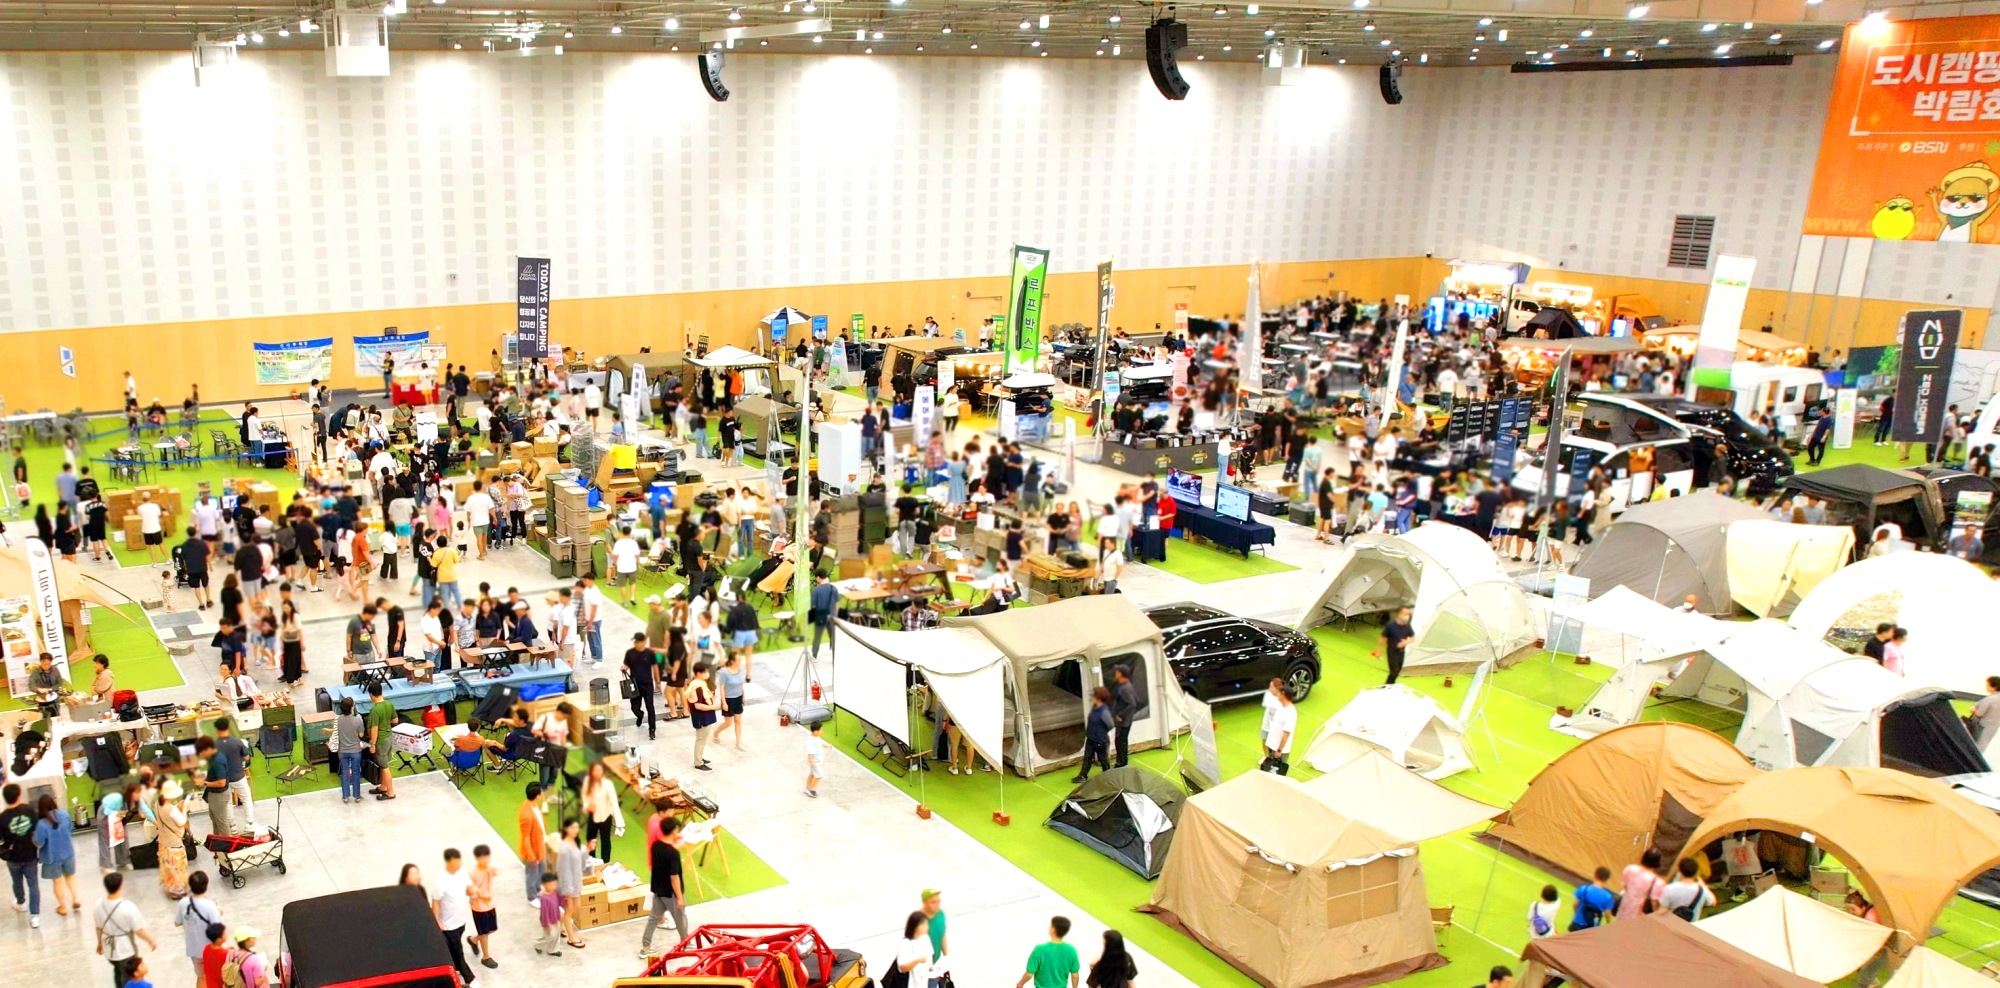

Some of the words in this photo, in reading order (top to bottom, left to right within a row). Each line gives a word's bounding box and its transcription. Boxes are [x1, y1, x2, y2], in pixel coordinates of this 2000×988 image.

[540, 263, 548, 302] TODAYS
[539, 307, 548, 352] CAMPING
[1023, 277, 1039, 350] 루프박스
[1921, 373, 1932, 396] ZED
